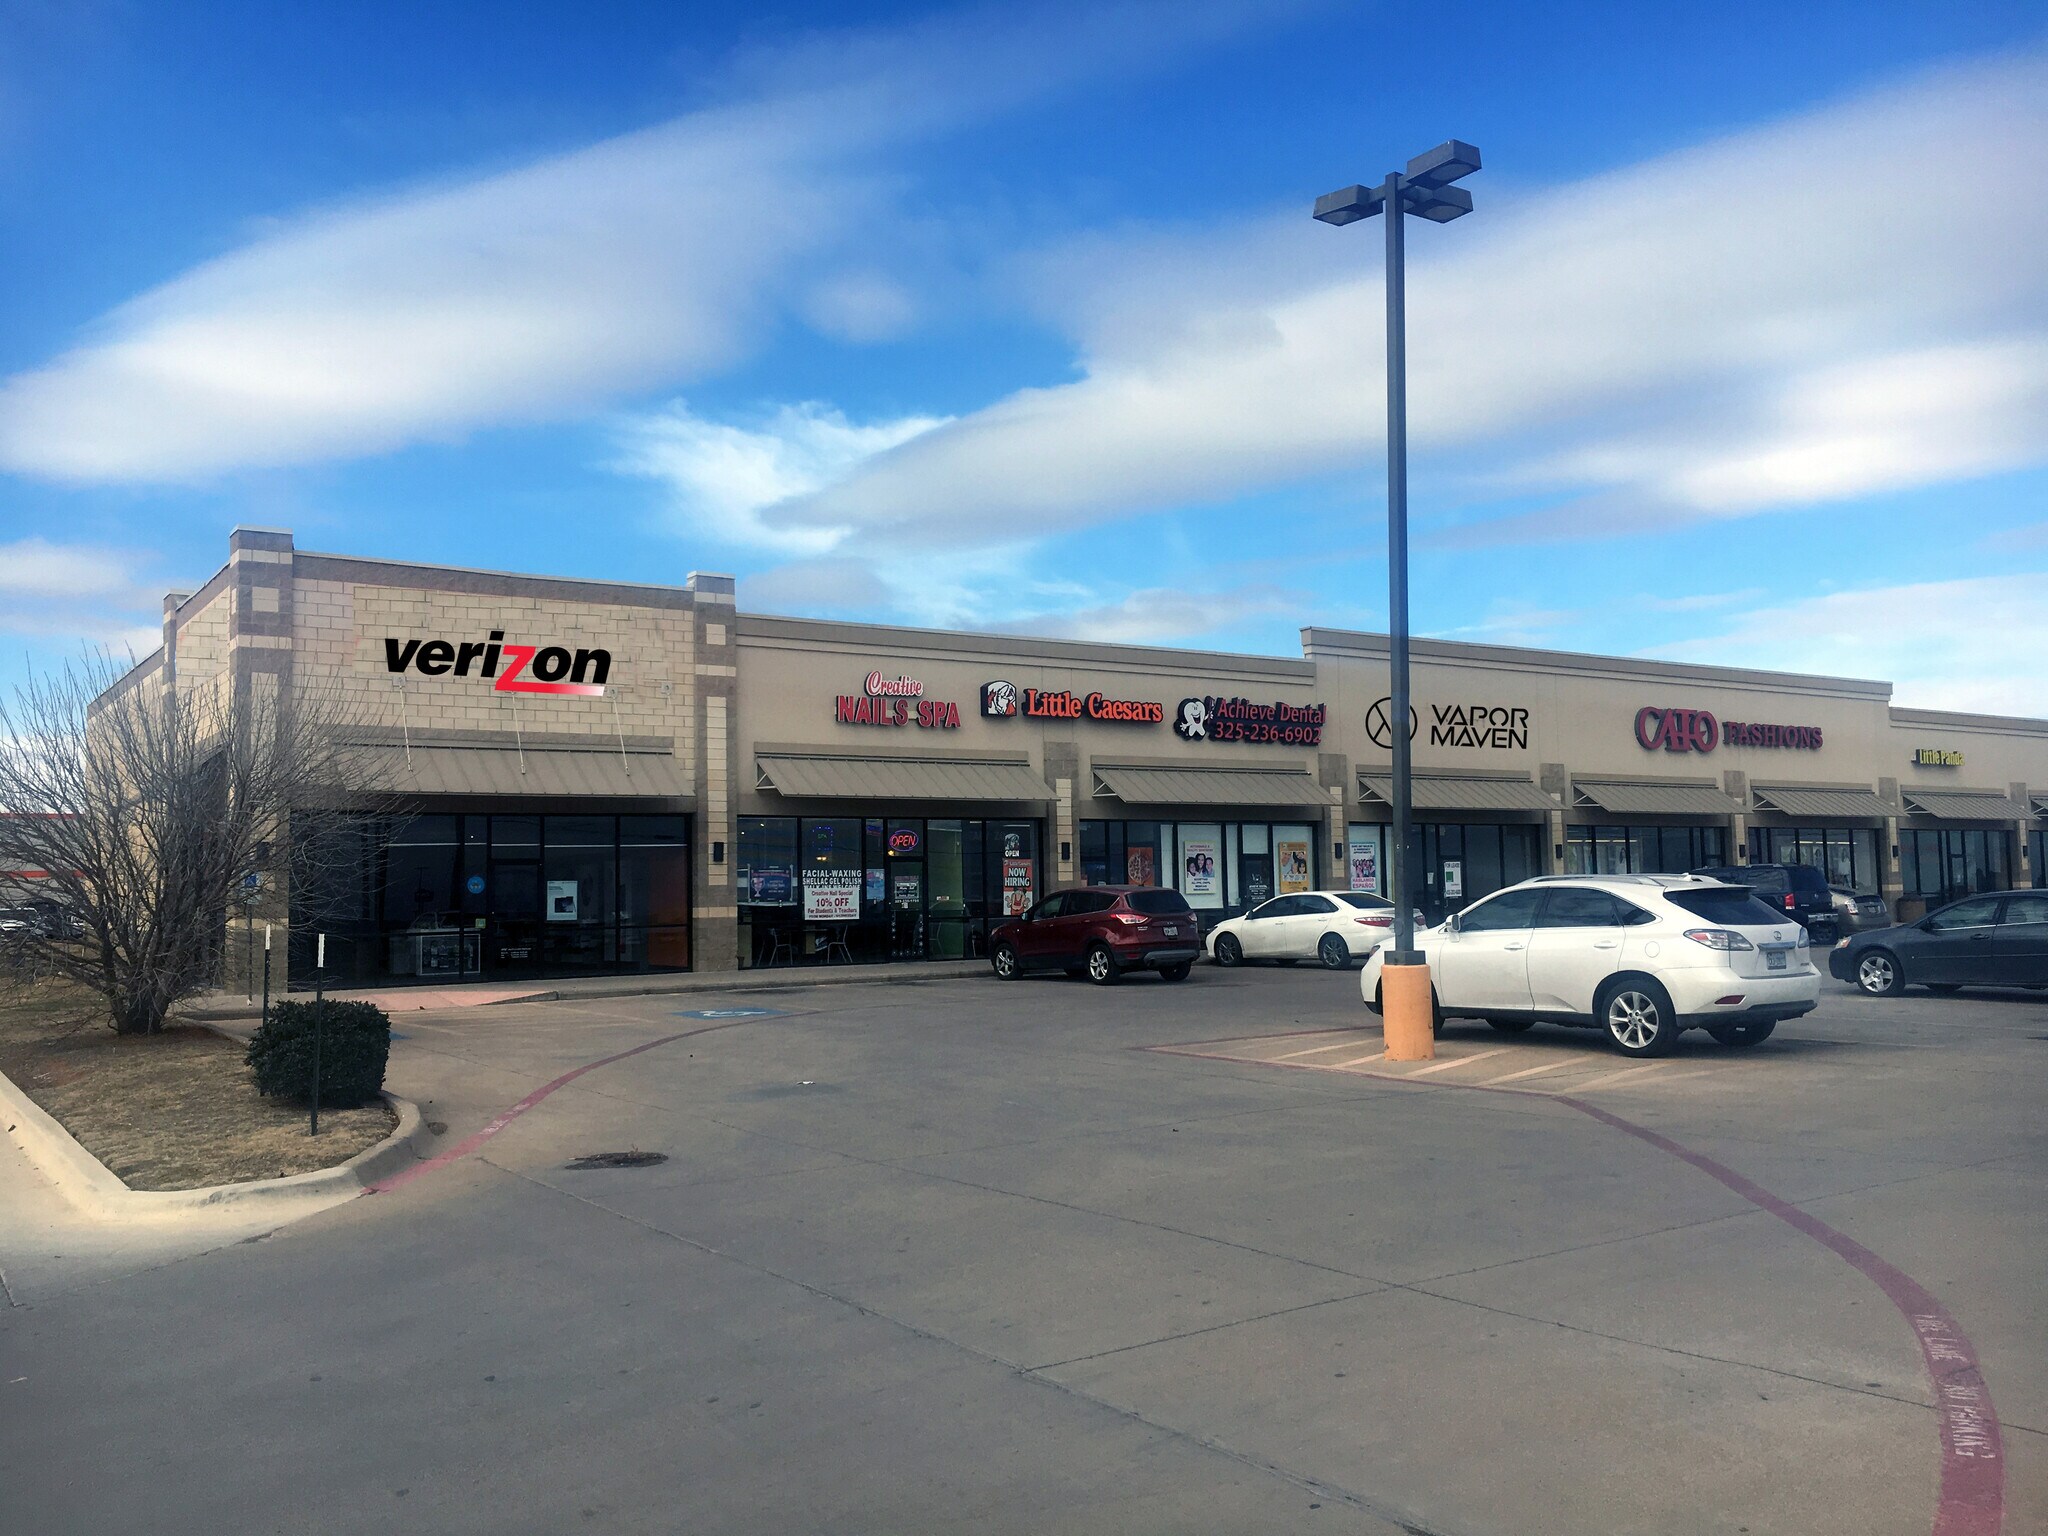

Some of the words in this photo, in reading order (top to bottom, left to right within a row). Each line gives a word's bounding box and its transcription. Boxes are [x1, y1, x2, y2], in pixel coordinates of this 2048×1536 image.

[385, 631, 611, 696] verizon
[866, 671, 923, 696] Creative
[837, 695, 909, 726] NAILS
[918, 700, 961, 728] SPA
[1026, 689, 1082, 718] Little
[1087, 692, 1164, 722] Caesars
[1217, 698, 1276, 721] Achieve
[1280, 703, 1327, 724] Dental
[1431, 704, 1529, 728] VAPOR
[1215, 721, 1322, 743] 325-236-6902
[1431, 725, 1528, 749] MAVEN
[1634, 706, 1719, 752] CATO
[1723, 721, 1824, 750] FASHIONS
[1920, 749, 1940, 765] Little
[1941, 750, 1965, 766] Panda
[890, 835, 916, 847] OPEN
[1004, 877, 1030, 887] HIRING
[1008, 867, 1026, 877] NOW
[816, 898, 833, 907] 10%
[834, 898, 849, 907] OFF
